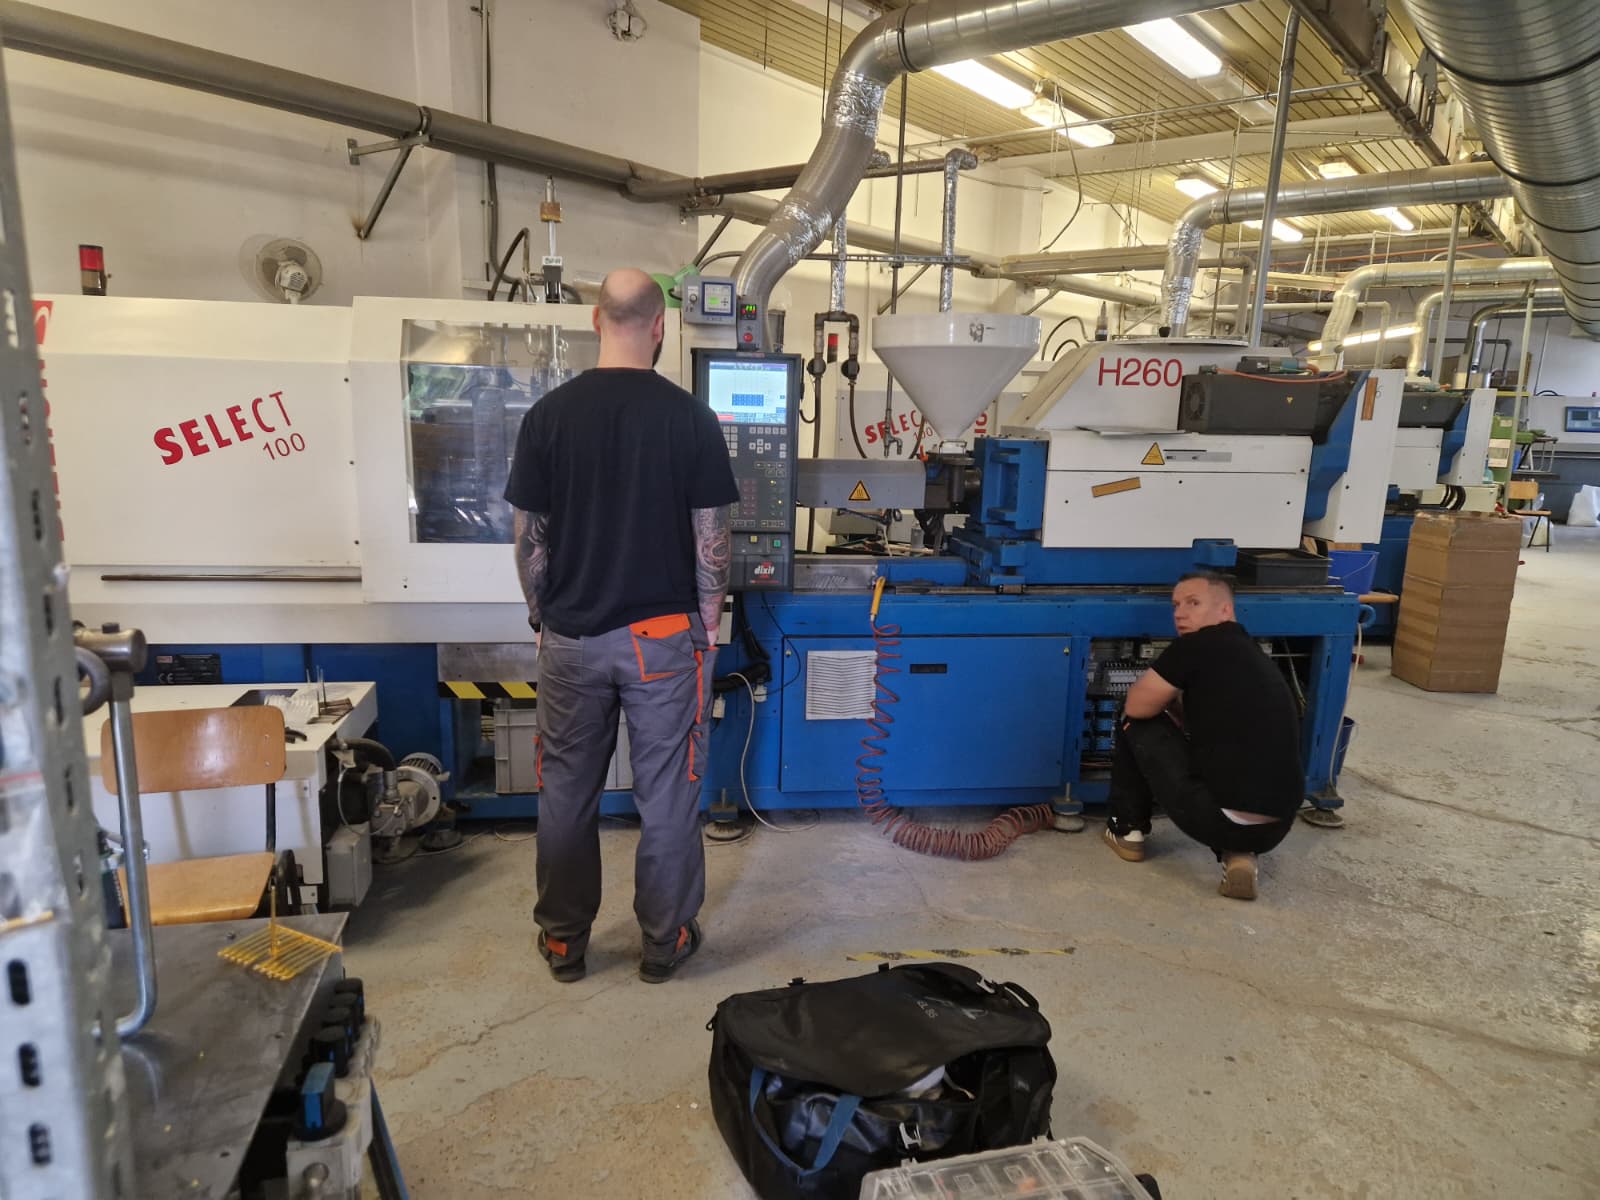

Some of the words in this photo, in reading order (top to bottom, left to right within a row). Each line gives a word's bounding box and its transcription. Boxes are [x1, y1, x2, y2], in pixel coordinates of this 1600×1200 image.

[1098, 357, 1183, 387] H260
[153, 391, 292, 465] SELECT
[263, 433, 306, 460] 100
